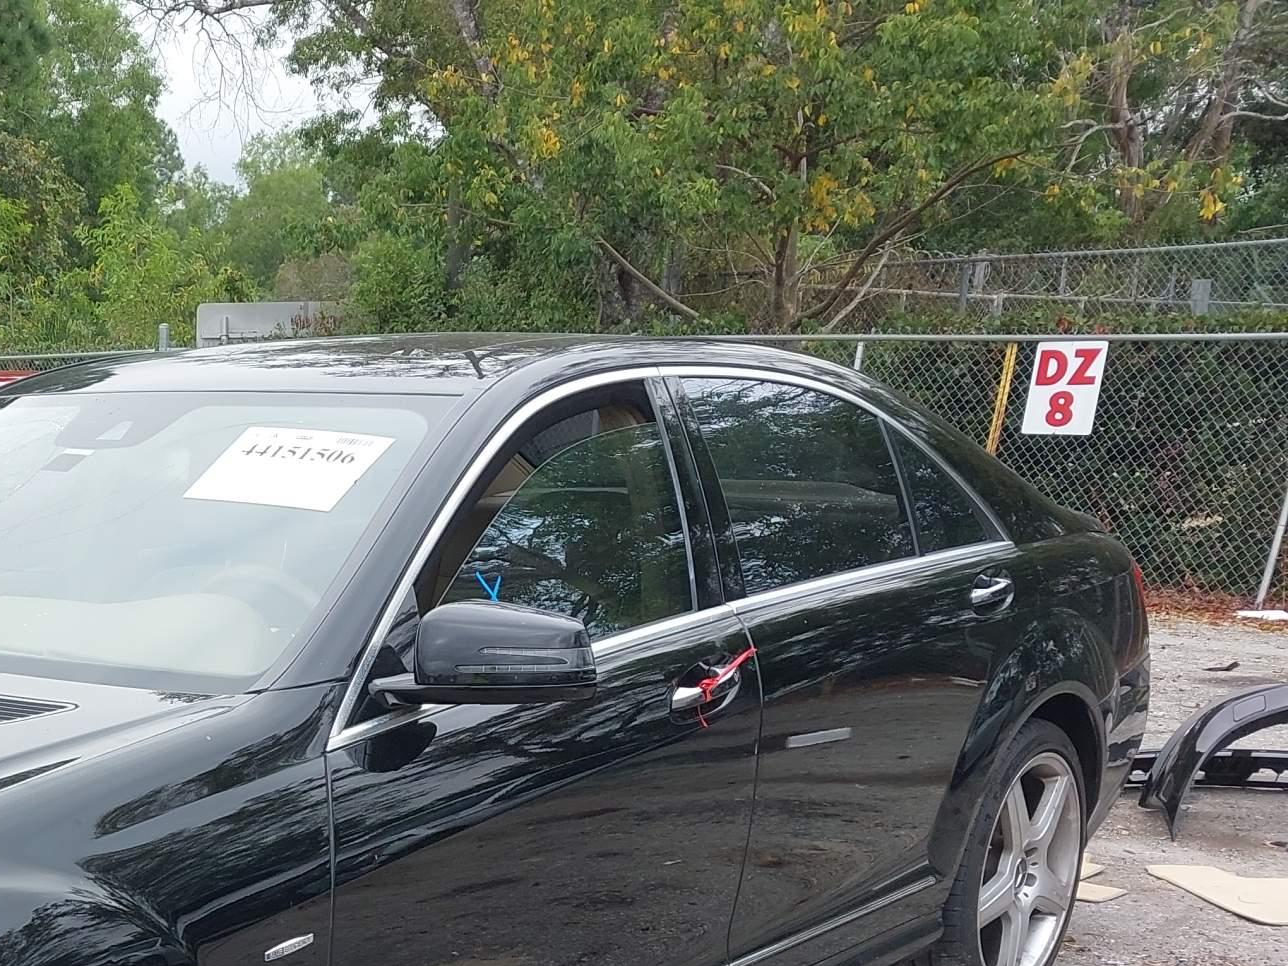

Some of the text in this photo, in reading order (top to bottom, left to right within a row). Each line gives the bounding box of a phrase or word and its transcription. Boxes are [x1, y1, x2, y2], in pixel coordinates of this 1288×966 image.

[1034, 348, 1104, 386] DZ
[1045, 390, 1074, 427] 8
[241, 443, 356, 464] 44151506
